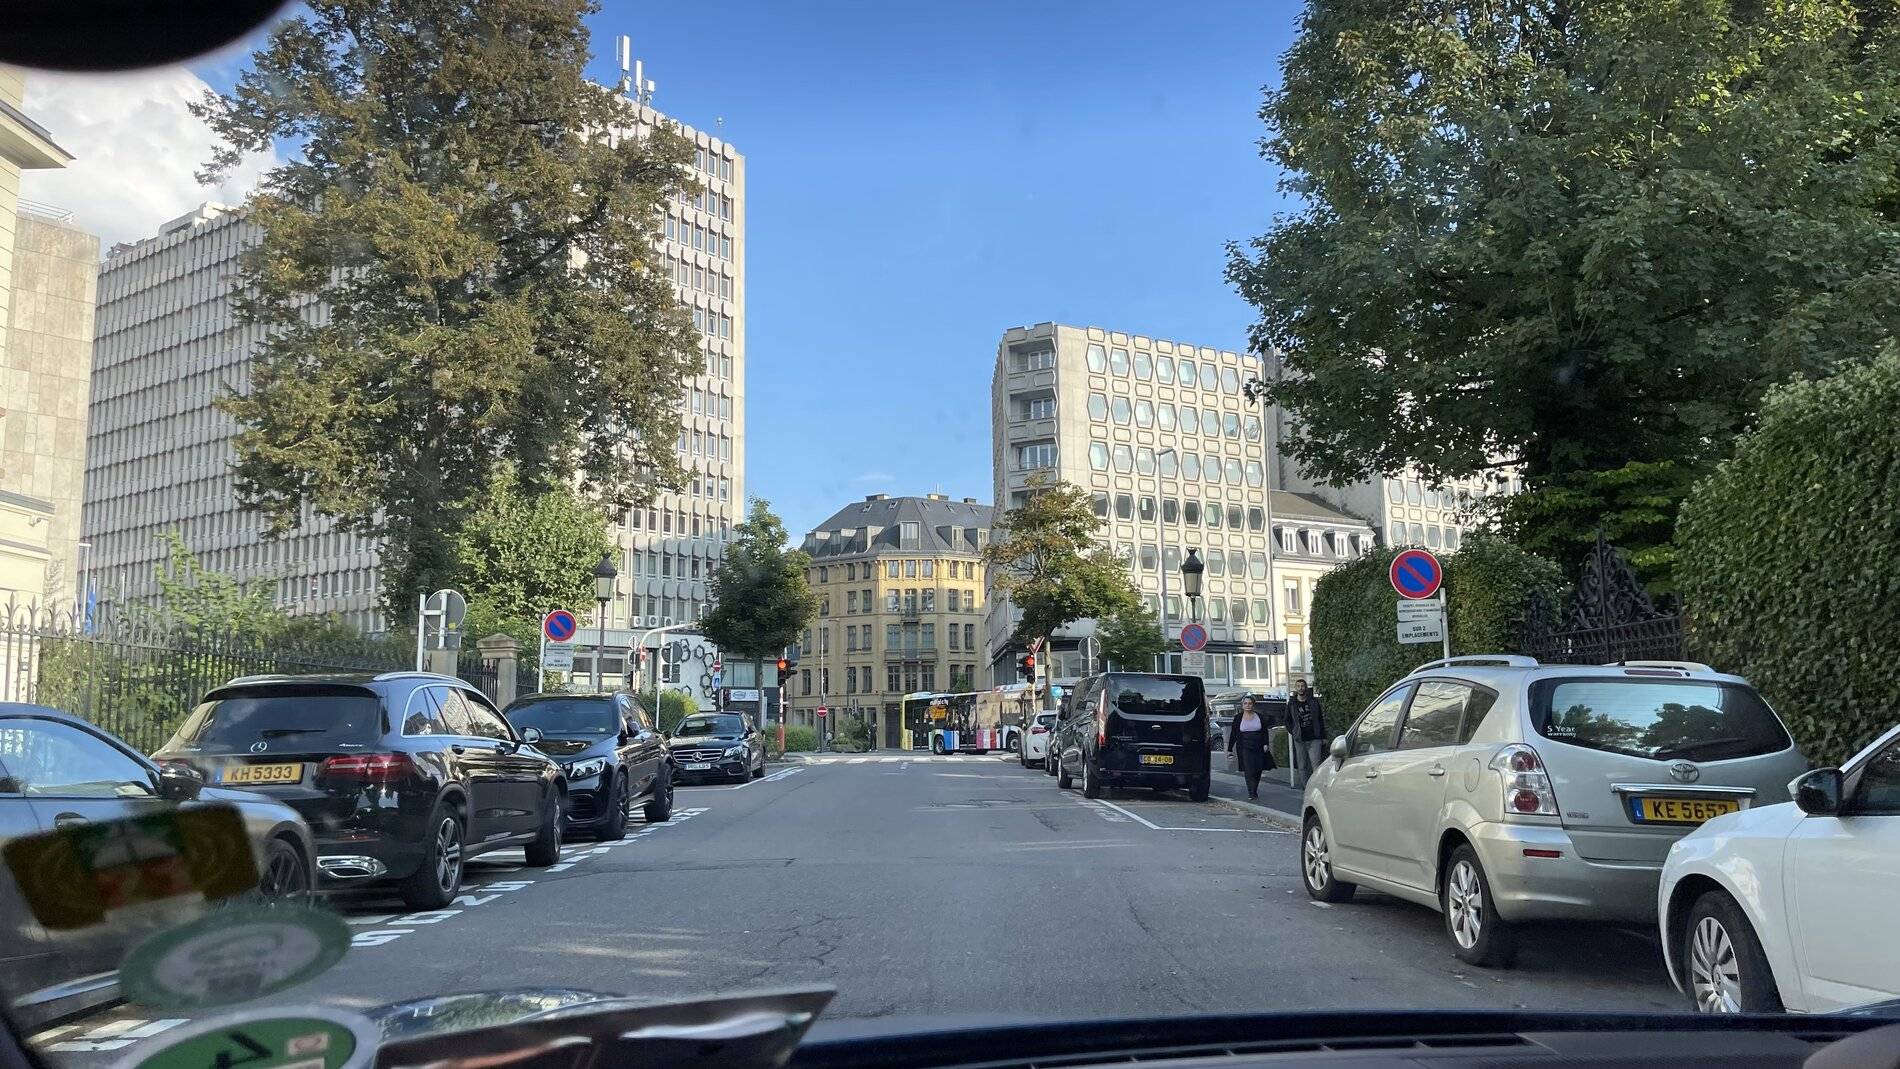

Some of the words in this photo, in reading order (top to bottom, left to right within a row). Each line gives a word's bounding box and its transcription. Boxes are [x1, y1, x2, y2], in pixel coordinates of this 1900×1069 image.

[230, 768, 250, 781] KH
[253, 766, 293, 780] 5333
[1652, 801, 1676, 818] KE
